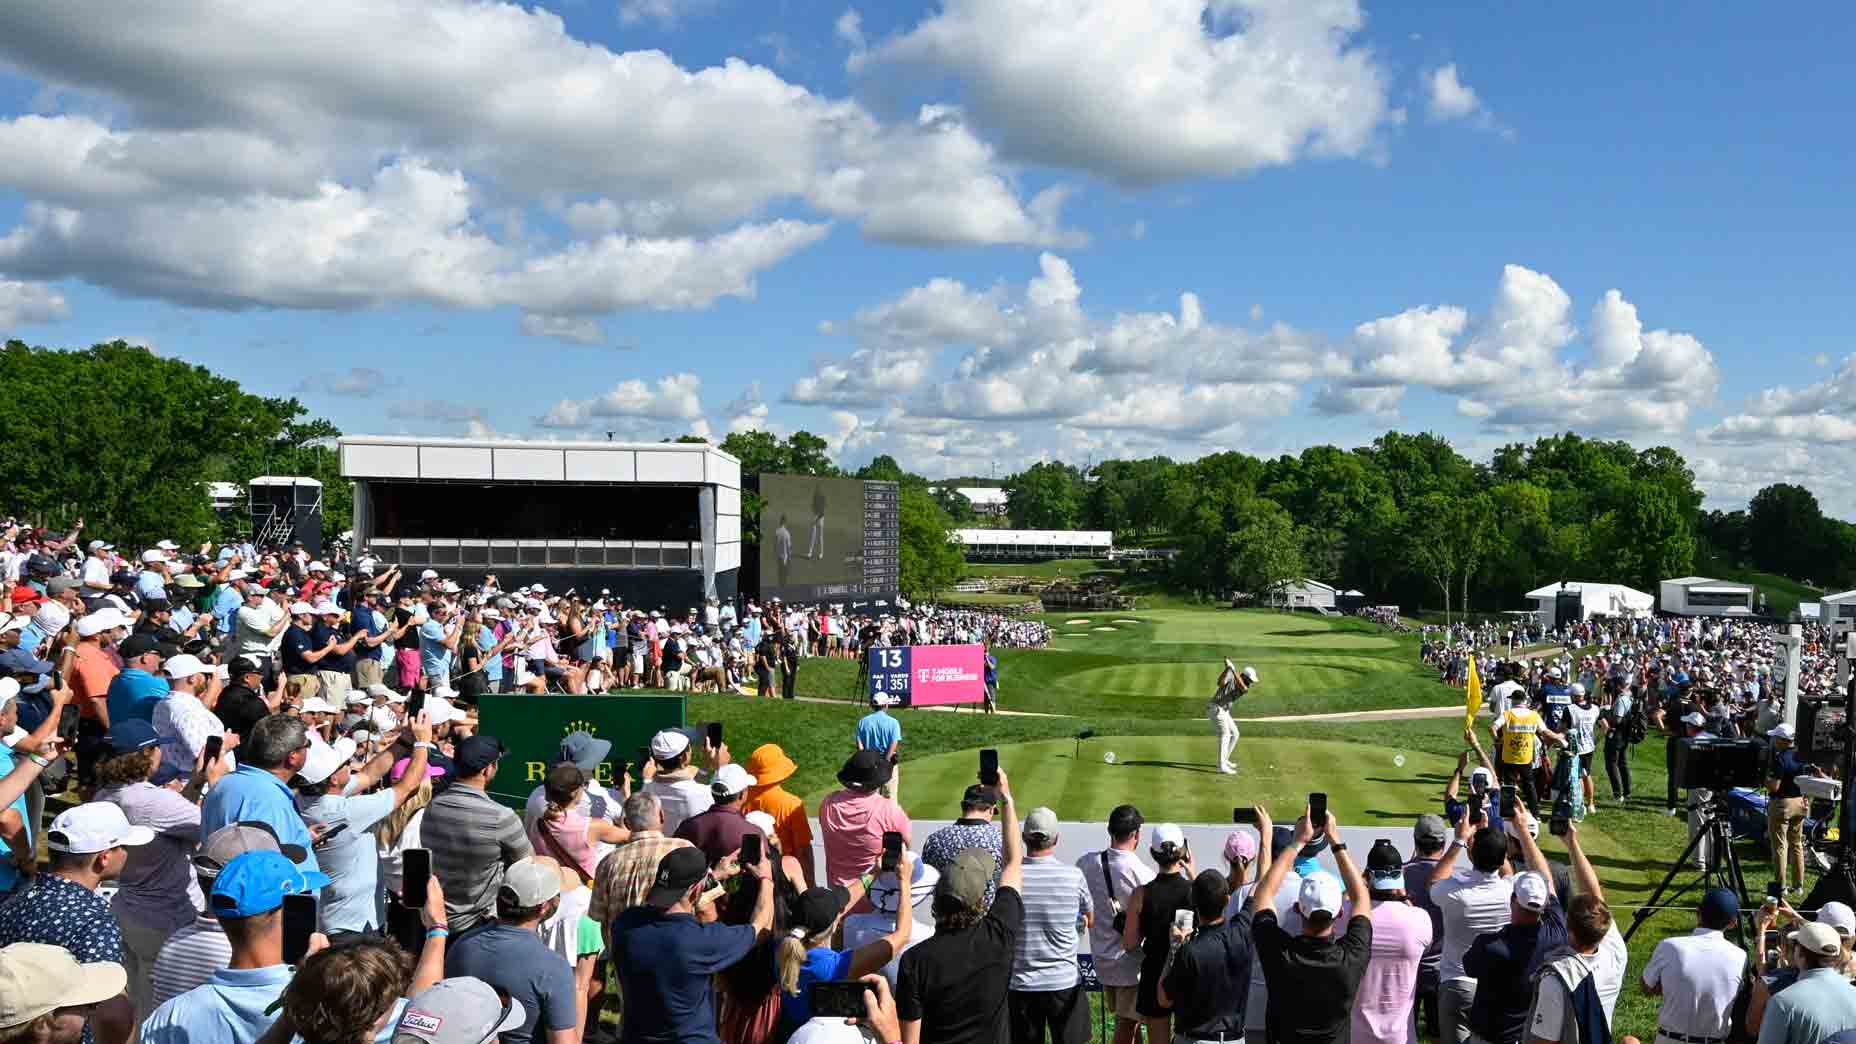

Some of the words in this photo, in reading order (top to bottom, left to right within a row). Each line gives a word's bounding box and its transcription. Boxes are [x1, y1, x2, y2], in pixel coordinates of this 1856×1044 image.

[879, 650, 902, 668] 13
[875, 679, 882, 690] 4
[890, 679, 908, 690] 351
